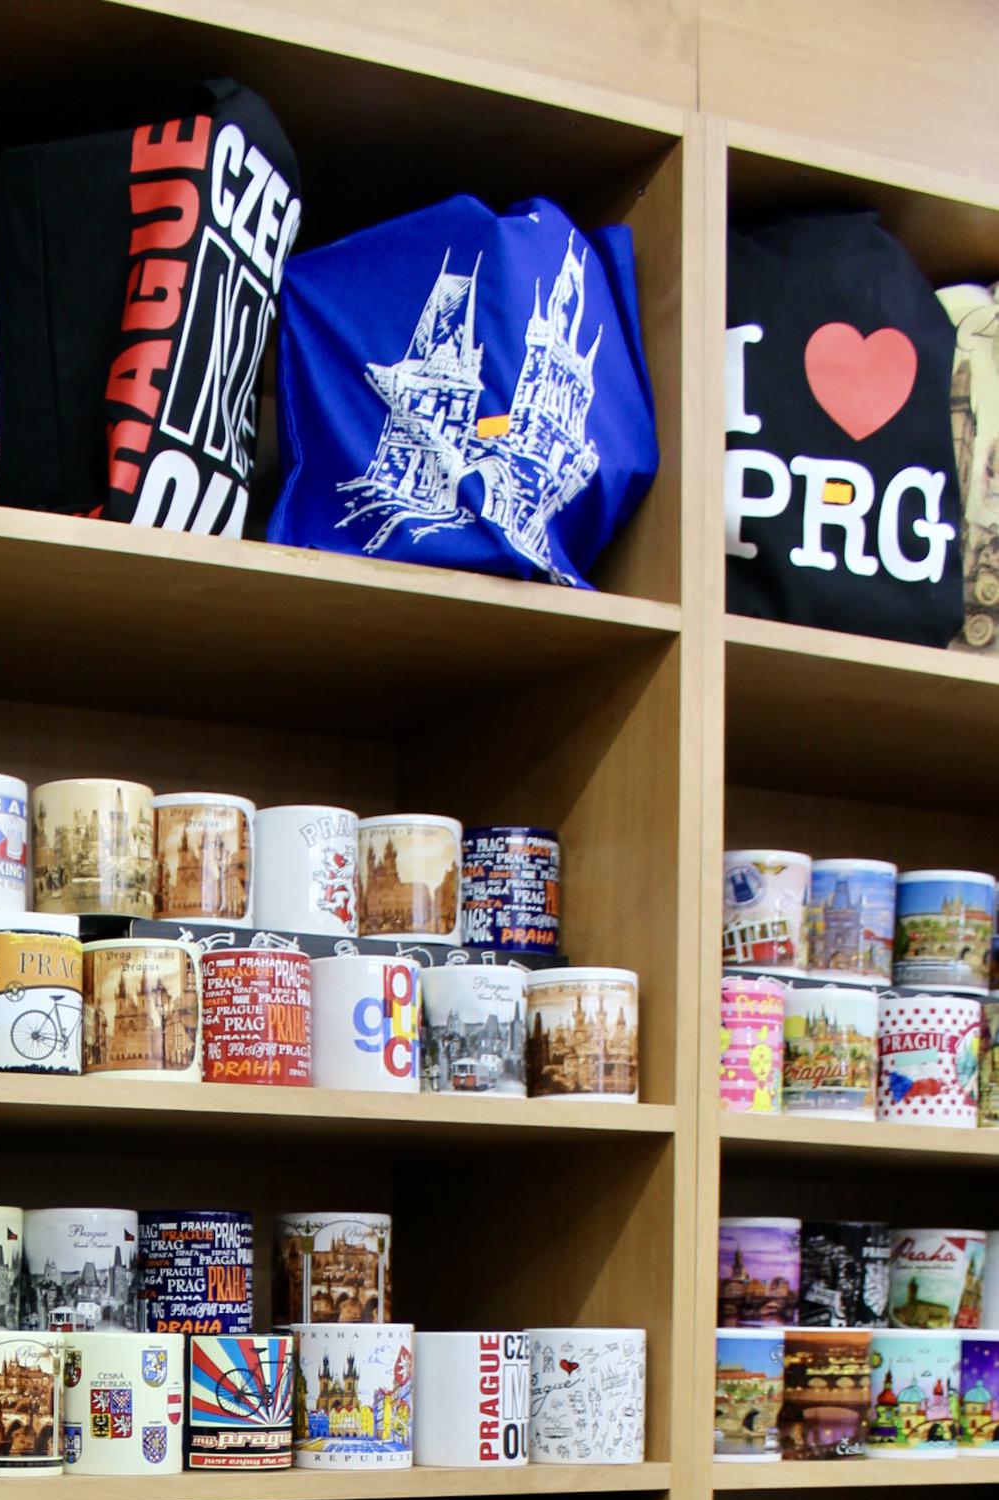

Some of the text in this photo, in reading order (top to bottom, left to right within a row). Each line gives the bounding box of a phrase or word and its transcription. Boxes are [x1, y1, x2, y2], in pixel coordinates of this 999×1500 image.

[726, 324, 763, 435] I
[726, 449, 955, 584] PRG
[512, 889, 546, 905] PRAG
[501, 928, 555, 945] PRAHA
[238, 957, 278, 968] PRAHA
[218, 967, 274, 978] PRAGUE
[274, 959, 301, 988] PRAG
[207, 976, 242, 990] PRAG
[258, 992, 297, 1005] PRAGA
[215, 1005, 263, 1016] PRAGUE
[223, 1016, 266, 1032] PRAG
[881, 1033, 951, 1053] PRAGUE
[212, 1059, 281, 1078] PRAHA
[67, 1224, 109, 1242] Prague
[181, 1222, 217, 1233] PRAHA
[161, 1230, 215, 1242] PRAGUE
[214, 1222, 242, 1249] PRAG
[151, 1239, 185, 1251] PRAG
[199, 1255, 237, 1266] PRAGA
[159, 1267, 205, 1277] PRAGUE
[167, 1279, 207, 1293] PRAG
[207, 1265, 247, 1303] PRAHA
[156, 1319, 223, 1333] PRAHA
[97, 1371, 125, 1380] ČESKÁ
[89, 1380, 133, 1388] REPUBLIKA
[479, 1334, 501, 1461] PRAGUE
[191, 1430, 292, 1451] my pragu
[203, 1456, 228, 1467] just
[228, 1457, 262, 1468] enjoy
